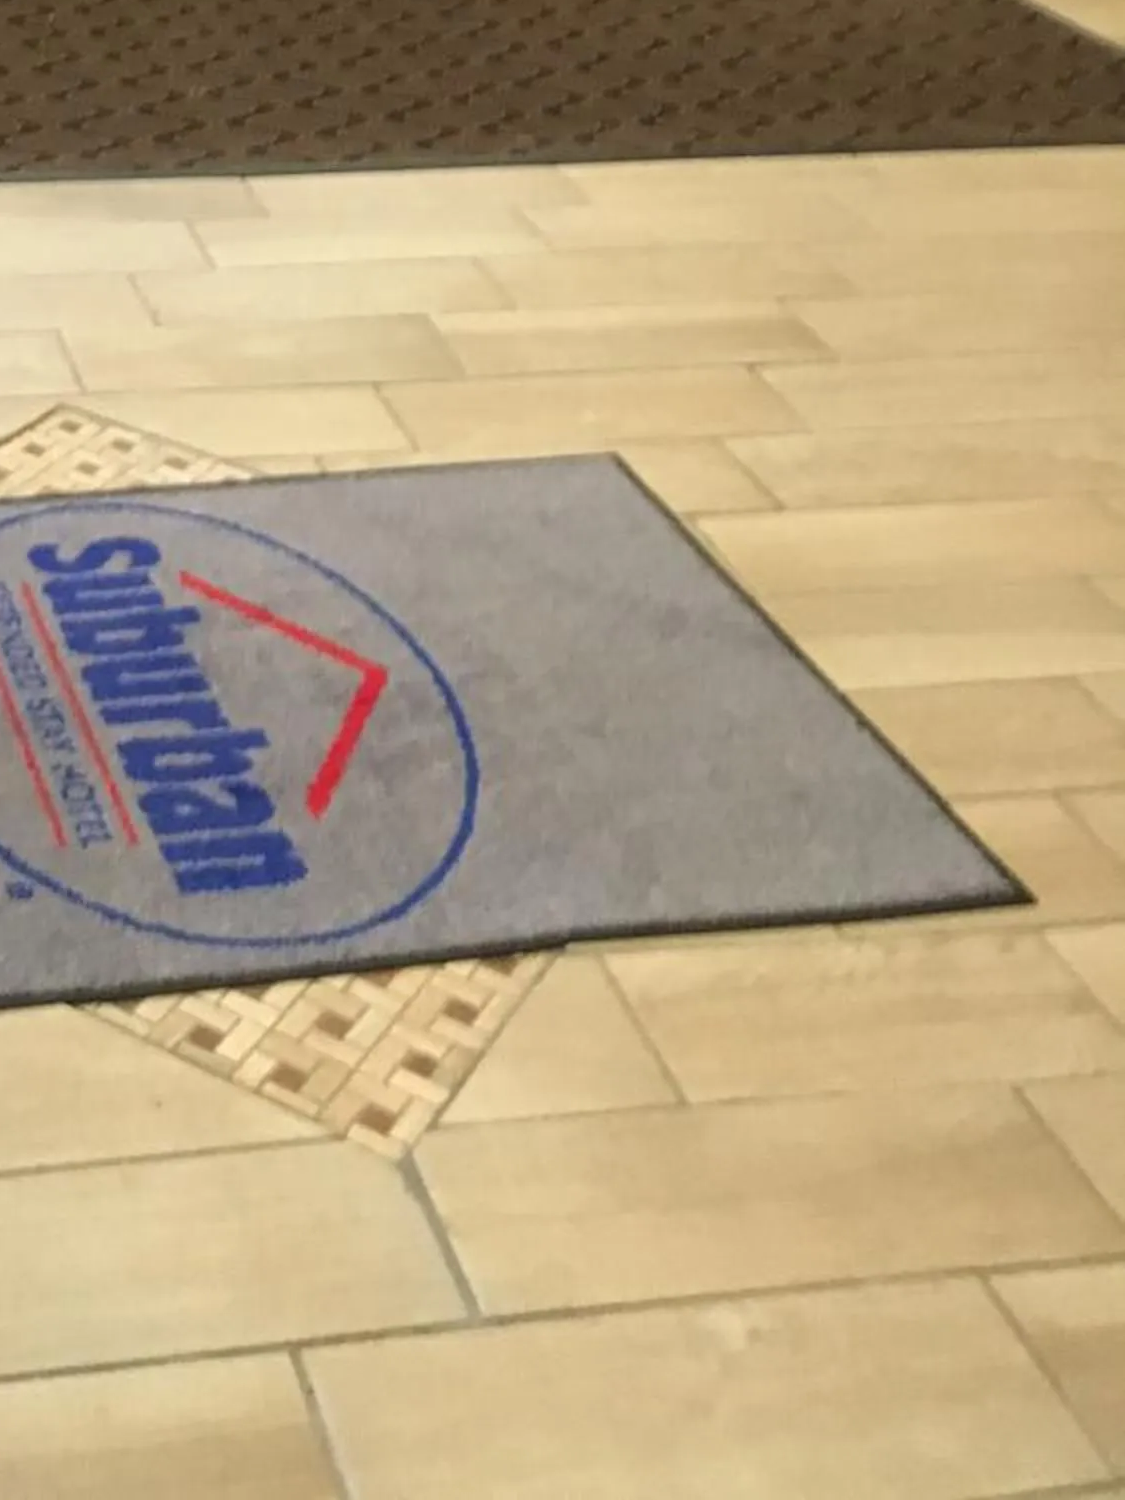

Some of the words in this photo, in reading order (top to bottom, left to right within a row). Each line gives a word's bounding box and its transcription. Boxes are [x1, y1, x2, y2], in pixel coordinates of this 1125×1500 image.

[26, 696, 75, 754] STAY
[52, 762, 113, 849] HOTEL
[28, 537, 308, 893] Suburban
